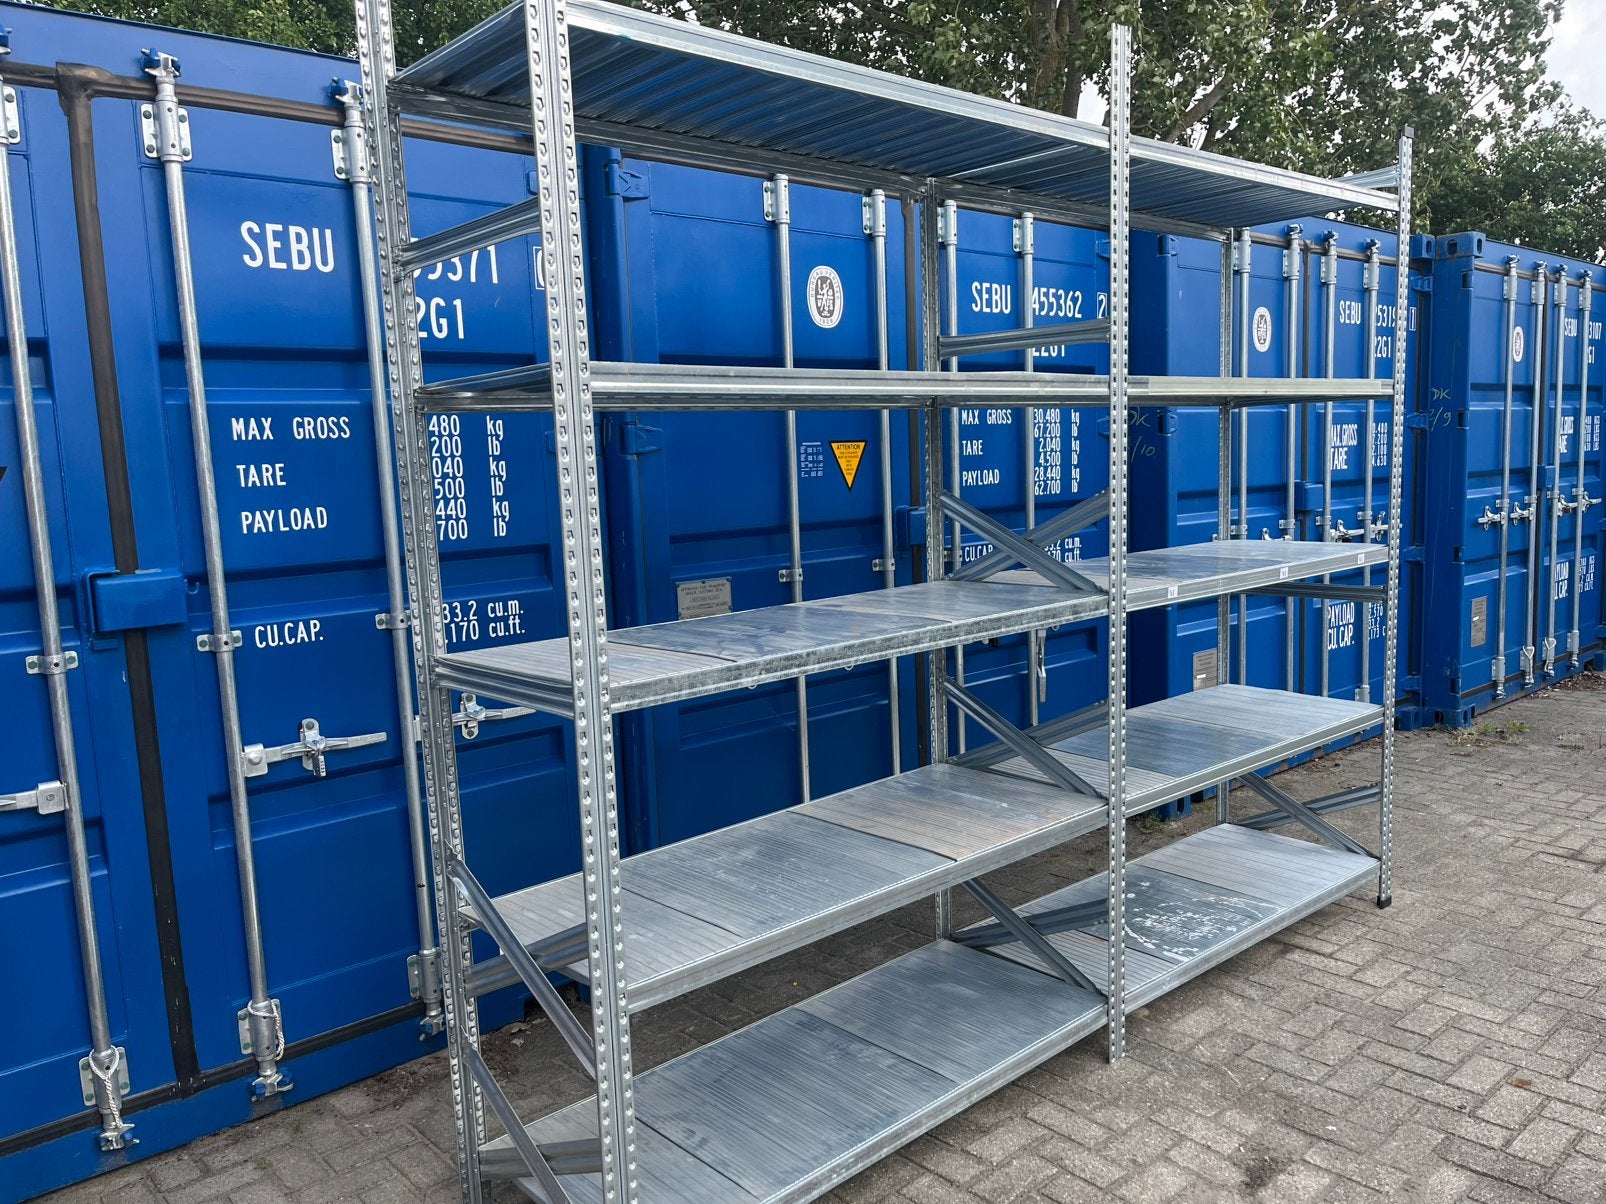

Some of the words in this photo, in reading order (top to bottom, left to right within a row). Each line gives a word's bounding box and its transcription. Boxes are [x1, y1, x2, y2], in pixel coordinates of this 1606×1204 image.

[240, 220, 335, 273] SEBU
[972, 281, 1011, 314] SEBU
[1032, 287, 1082, 318] 455362
[1339, 300, 1361, 325] SEBU
[231, 417, 274, 441] MAX
[292, 416, 351, 440] GROSS
[429, 415, 460, 436] 480
[486, 415, 504, 441] kg
[961, 409, 979, 425] MAX
[986, 409, 1012, 425] GROSS
[1034, 408, 1060, 423] 30.480
[1071, 408, 1080, 427] kg
[1034, 423, 1060, 437] 67.200
[1071, 423, 1078, 437] lb
[431, 436, 462, 457] 200
[487, 435, 501, 456] lb
[962, 439, 983, 456] TARE
[1039, 437, 1061, 452] 2.040
[1071, 437, 1080, 455] kg
[1039, 451, 1061, 466] 4.500
[1071, 451, 1078, 465] lb
[1330, 447, 1348, 470] TARE
[236, 463, 287, 487] TARE
[432, 457, 464, 478] 040
[489, 456, 507, 481] kg
[962, 469, 1000, 486] PAYLOAD
[1034, 466, 1061, 481] 28.440
[1071, 465, 1080, 483] kg
[434, 478, 465, 499] 500
[491, 476, 504, 496] lb
[1034, 480, 1061, 495] 62.700
[1071, 479, 1078, 493] lb
[241, 506, 328, 534] PAYLOAD
[435, 498, 467, 519] 440
[492, 497, 510, 522] kg
[437, 519, 468, 541] 700
[493, 517, 507, 537] lb
[254, 620, 324, 649] CU.CAP.
[487, 599, 524, 618] cu.m.
[1328, 601, 1355, 627] PAYLOAD
[489, 615, 526, 638] cu.ft.
